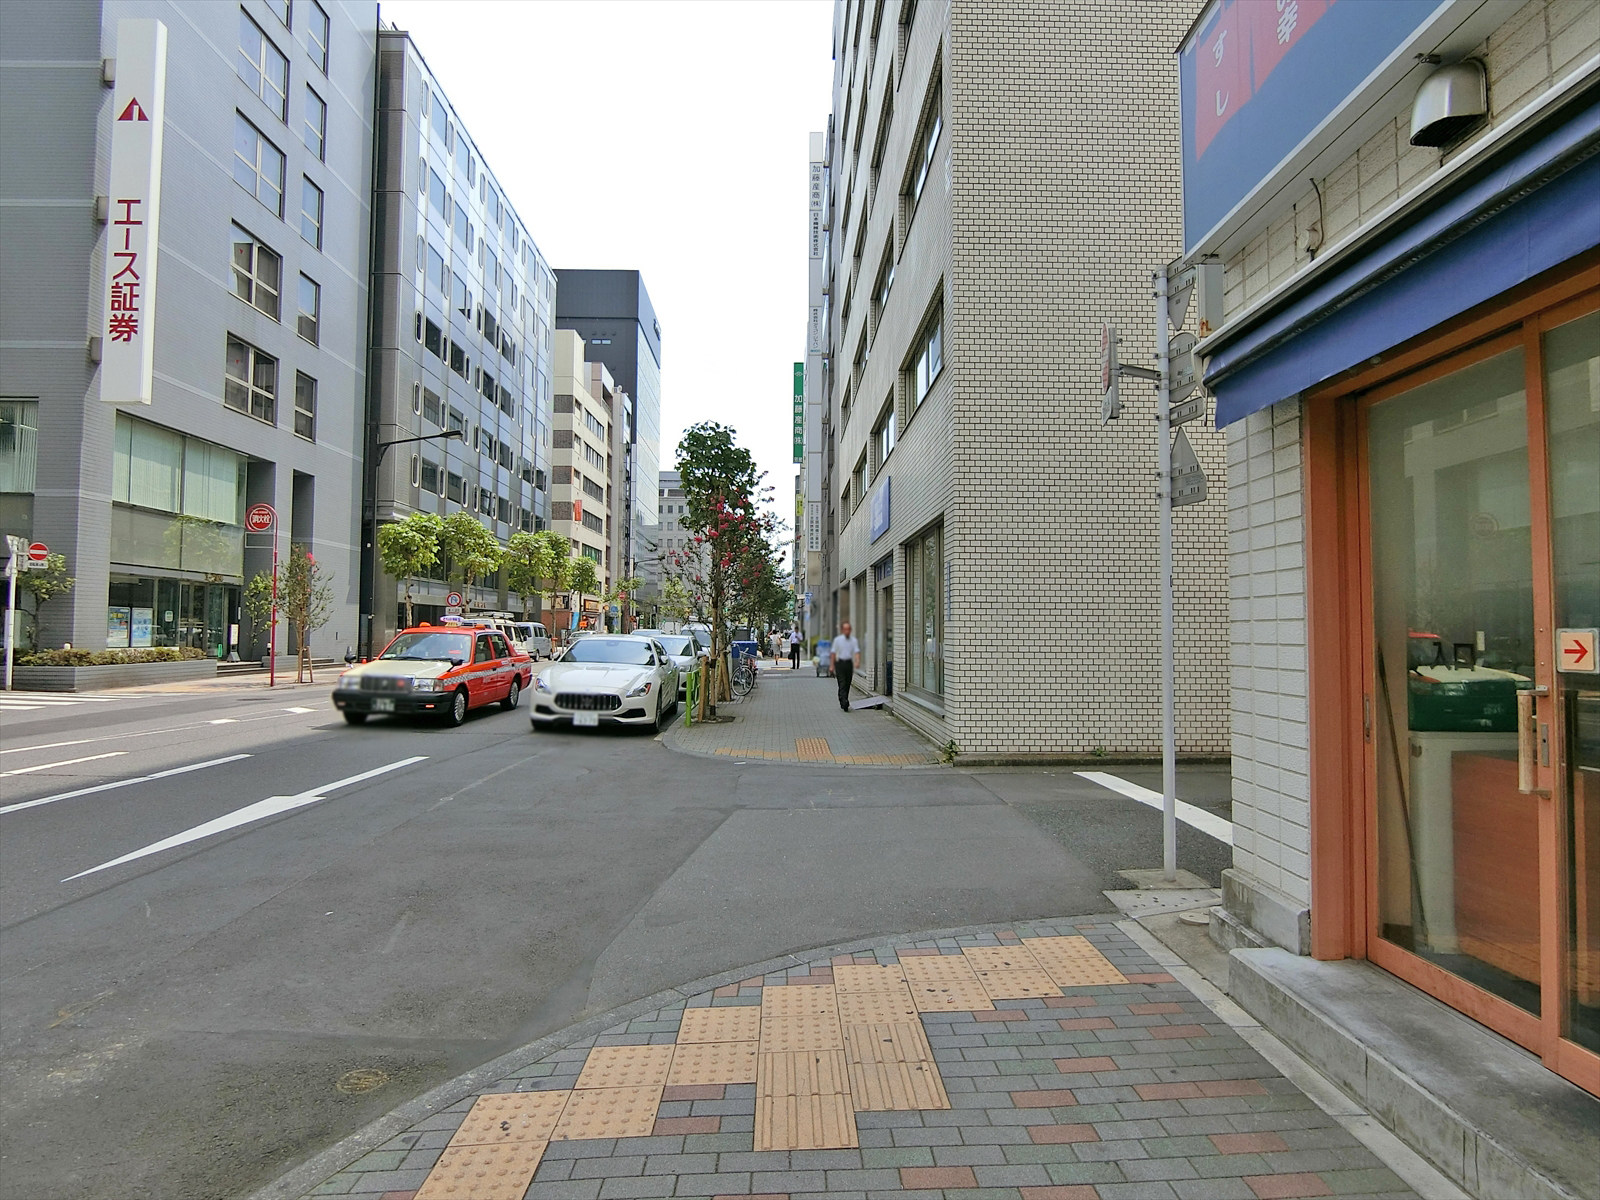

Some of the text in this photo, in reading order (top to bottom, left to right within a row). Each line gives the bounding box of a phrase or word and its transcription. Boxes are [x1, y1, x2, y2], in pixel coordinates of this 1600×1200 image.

[1212, 29, 1229, 117] すし
[109, 199, 143, 342] エース証券
[252, 515, 270, 523] 消火栓
